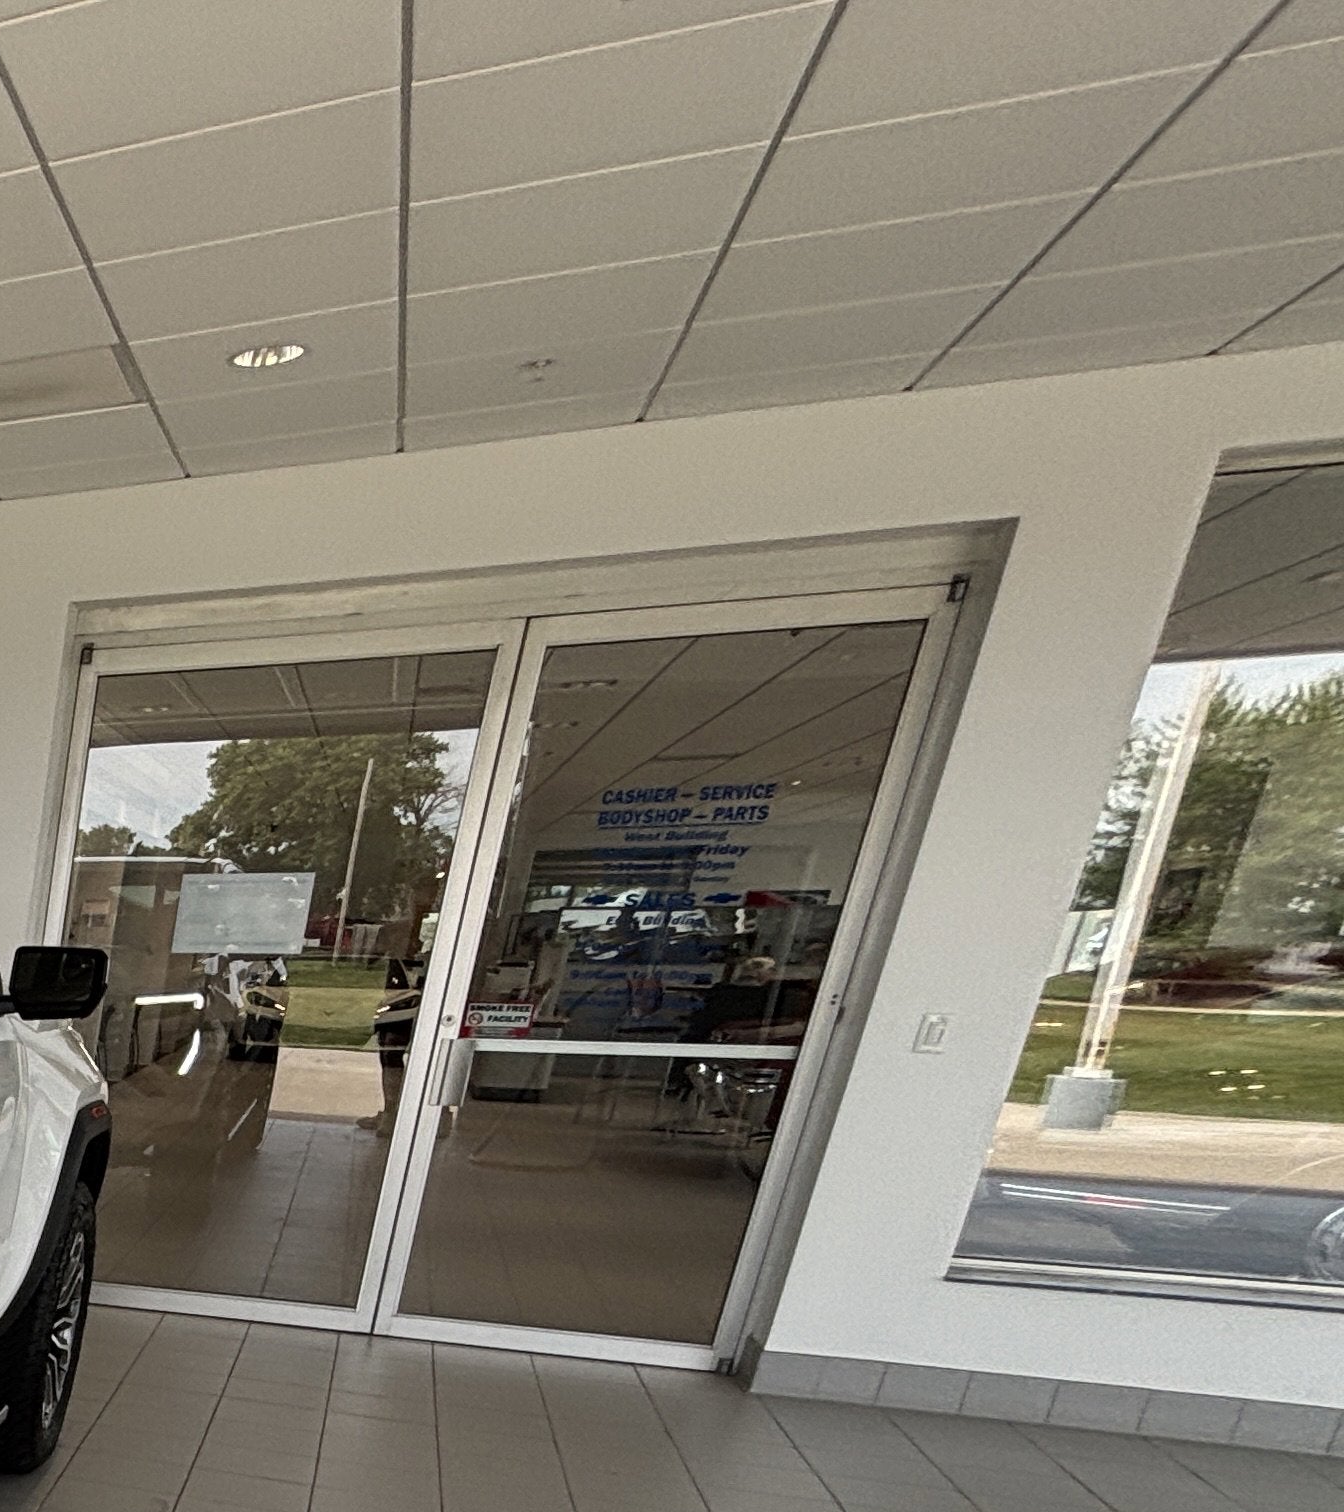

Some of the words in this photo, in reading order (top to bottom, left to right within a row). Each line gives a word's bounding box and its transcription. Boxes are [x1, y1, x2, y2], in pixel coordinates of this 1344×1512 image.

[602, 786, 678, 805] CASHIER
[699, 783, 778, 801] SERVICE
[597, 807, 692, 827] BODYSHOP
[711, 804, 770, 822] PARTS
[697, 844, 752, 857] Friday
[624, 890, 697, 909] SALES
[470, 1004, 505, 1012] SMOKE
[506, 1005, 531, 1013] FREE
[487, 1014, 529, 1023] FACILITY
